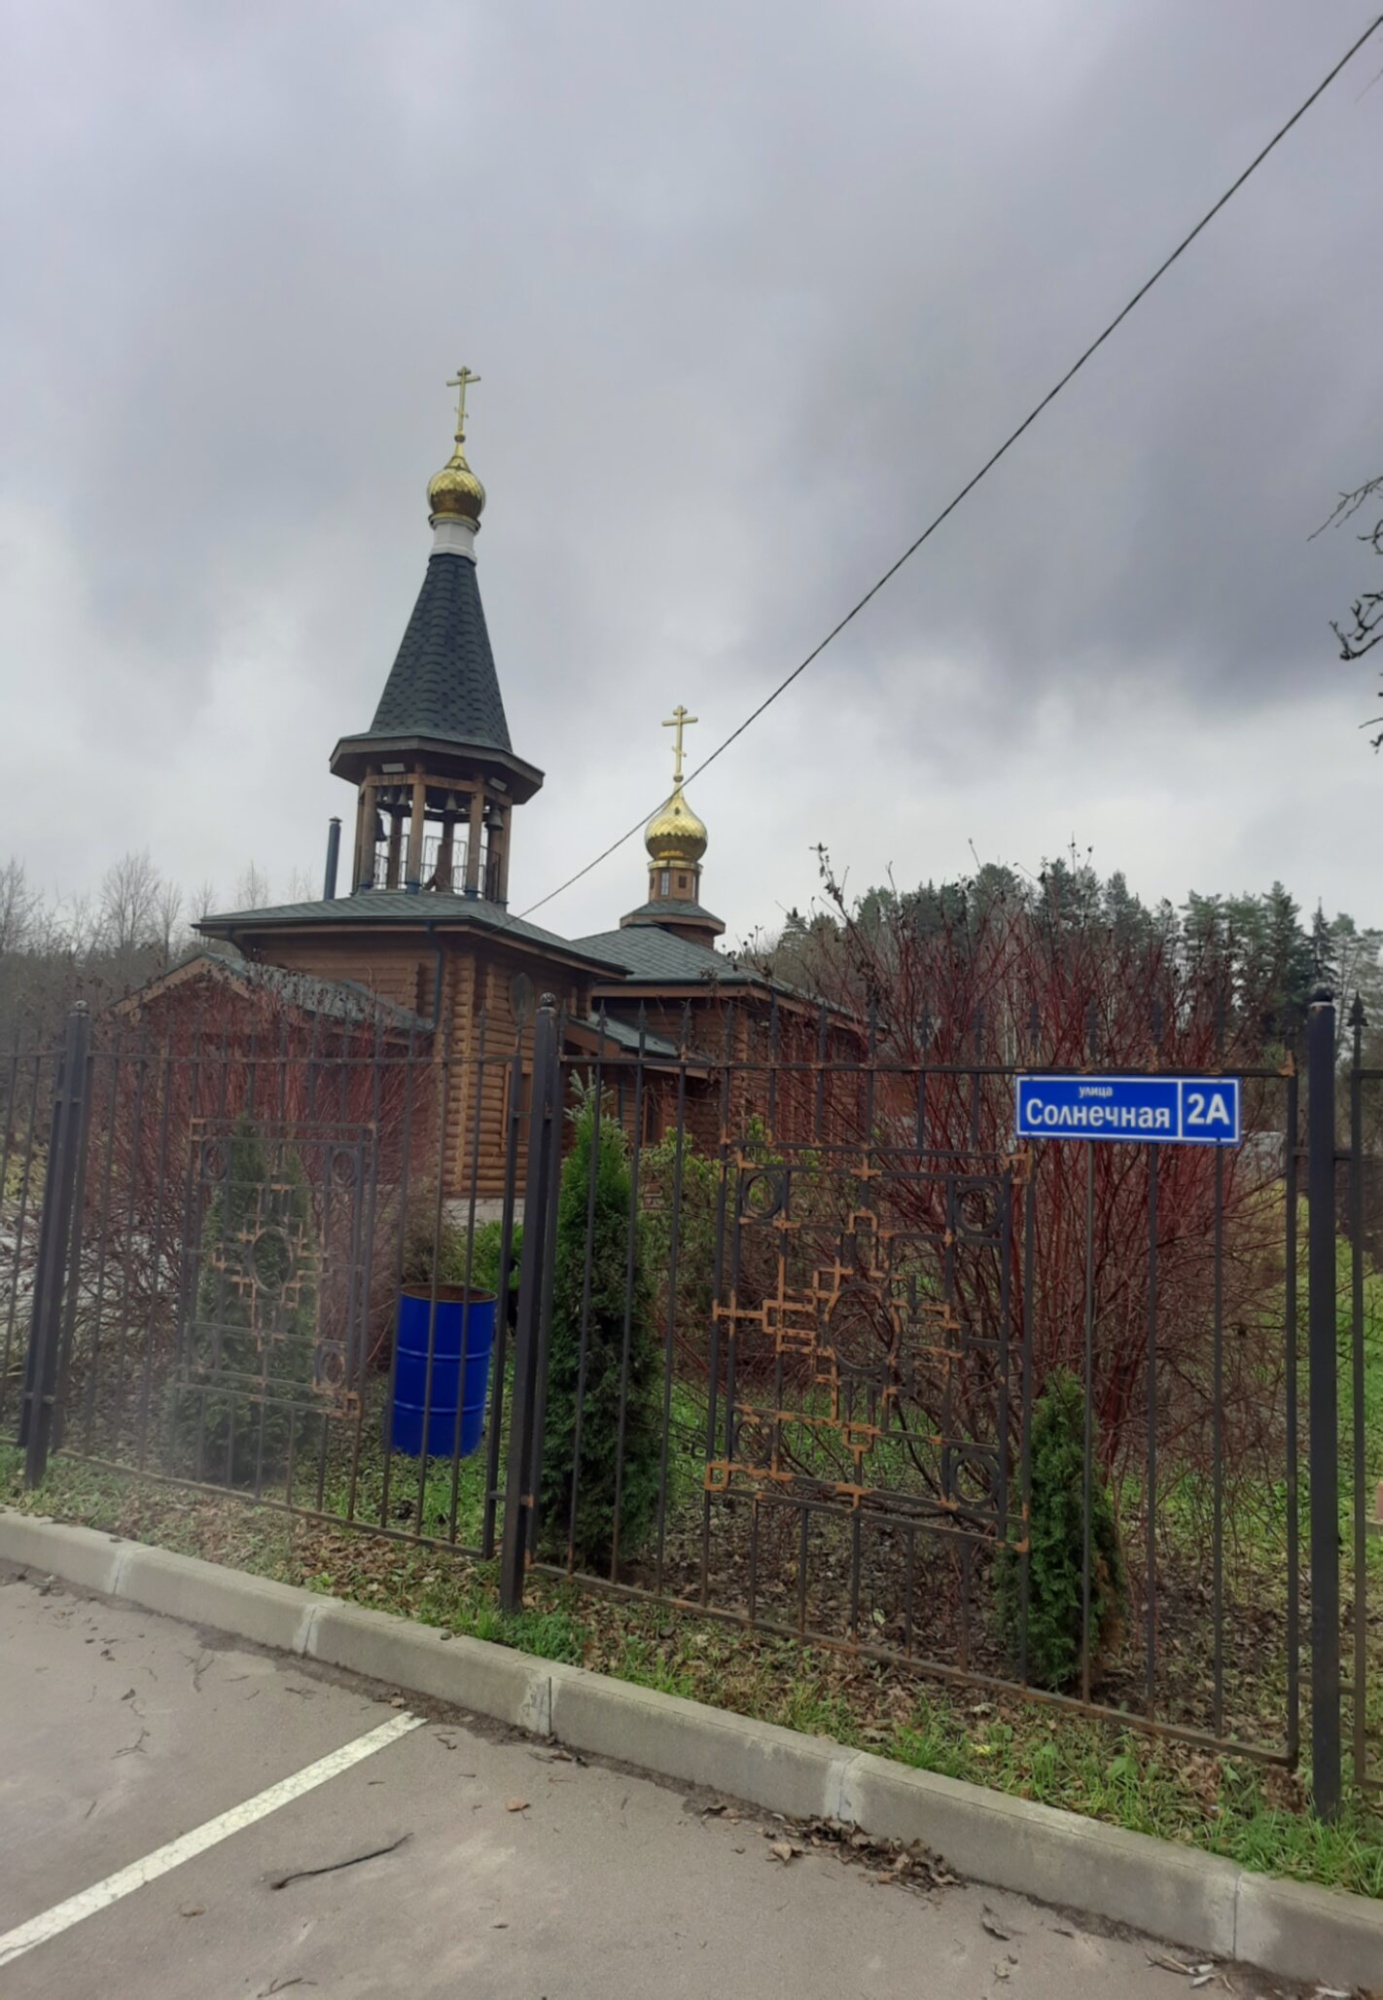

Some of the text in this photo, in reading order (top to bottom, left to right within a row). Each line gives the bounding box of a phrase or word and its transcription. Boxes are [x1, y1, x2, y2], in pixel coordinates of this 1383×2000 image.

[1079, 1086, 1113, 1098] улица
[1026, 1098, 1170, 1128] Солнечная
[1187, 1093, 1230, 1125] 2А
